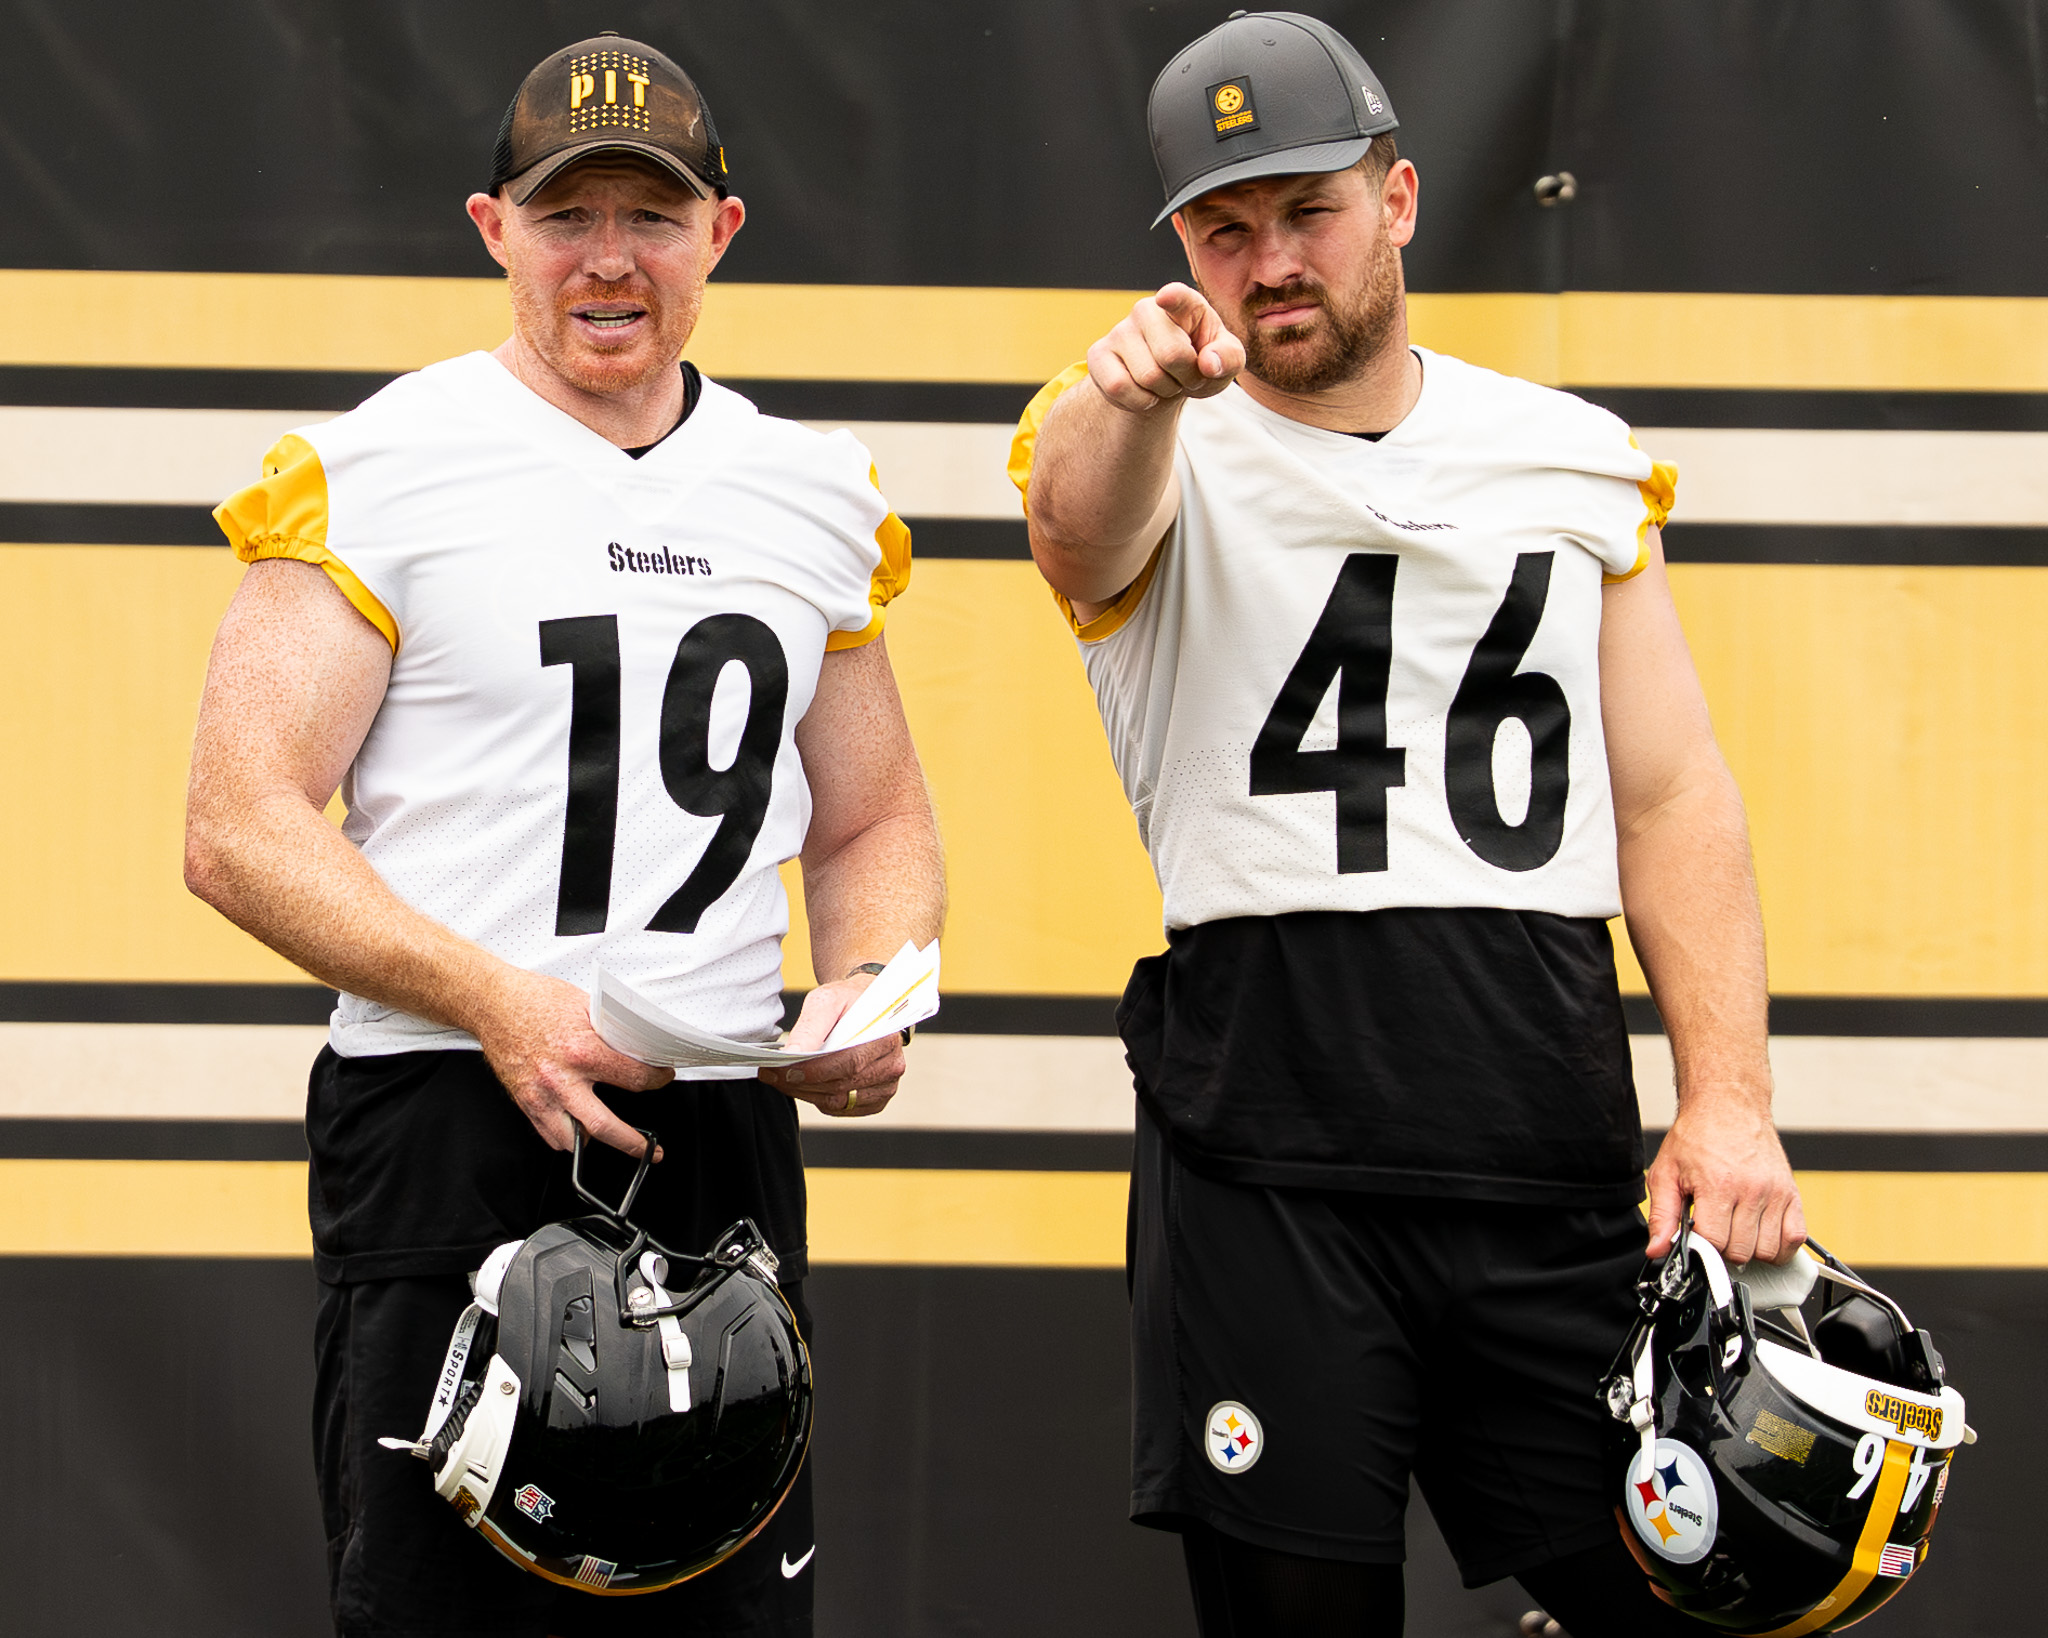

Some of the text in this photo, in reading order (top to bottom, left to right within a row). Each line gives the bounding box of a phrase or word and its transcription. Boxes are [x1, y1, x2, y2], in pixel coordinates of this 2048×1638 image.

[570, 69, 650, 109] PIT
[1216, 114, 1254, 131] STEELERS
[607, 541, 712, 576] Steelers
[1249, 551, 1571, 874] 46
[539, 612, 789, 936] 19
[1865, 1389, 1943, 1442] Steelers
[1669, 1502, 1702, 1526] Steelers
